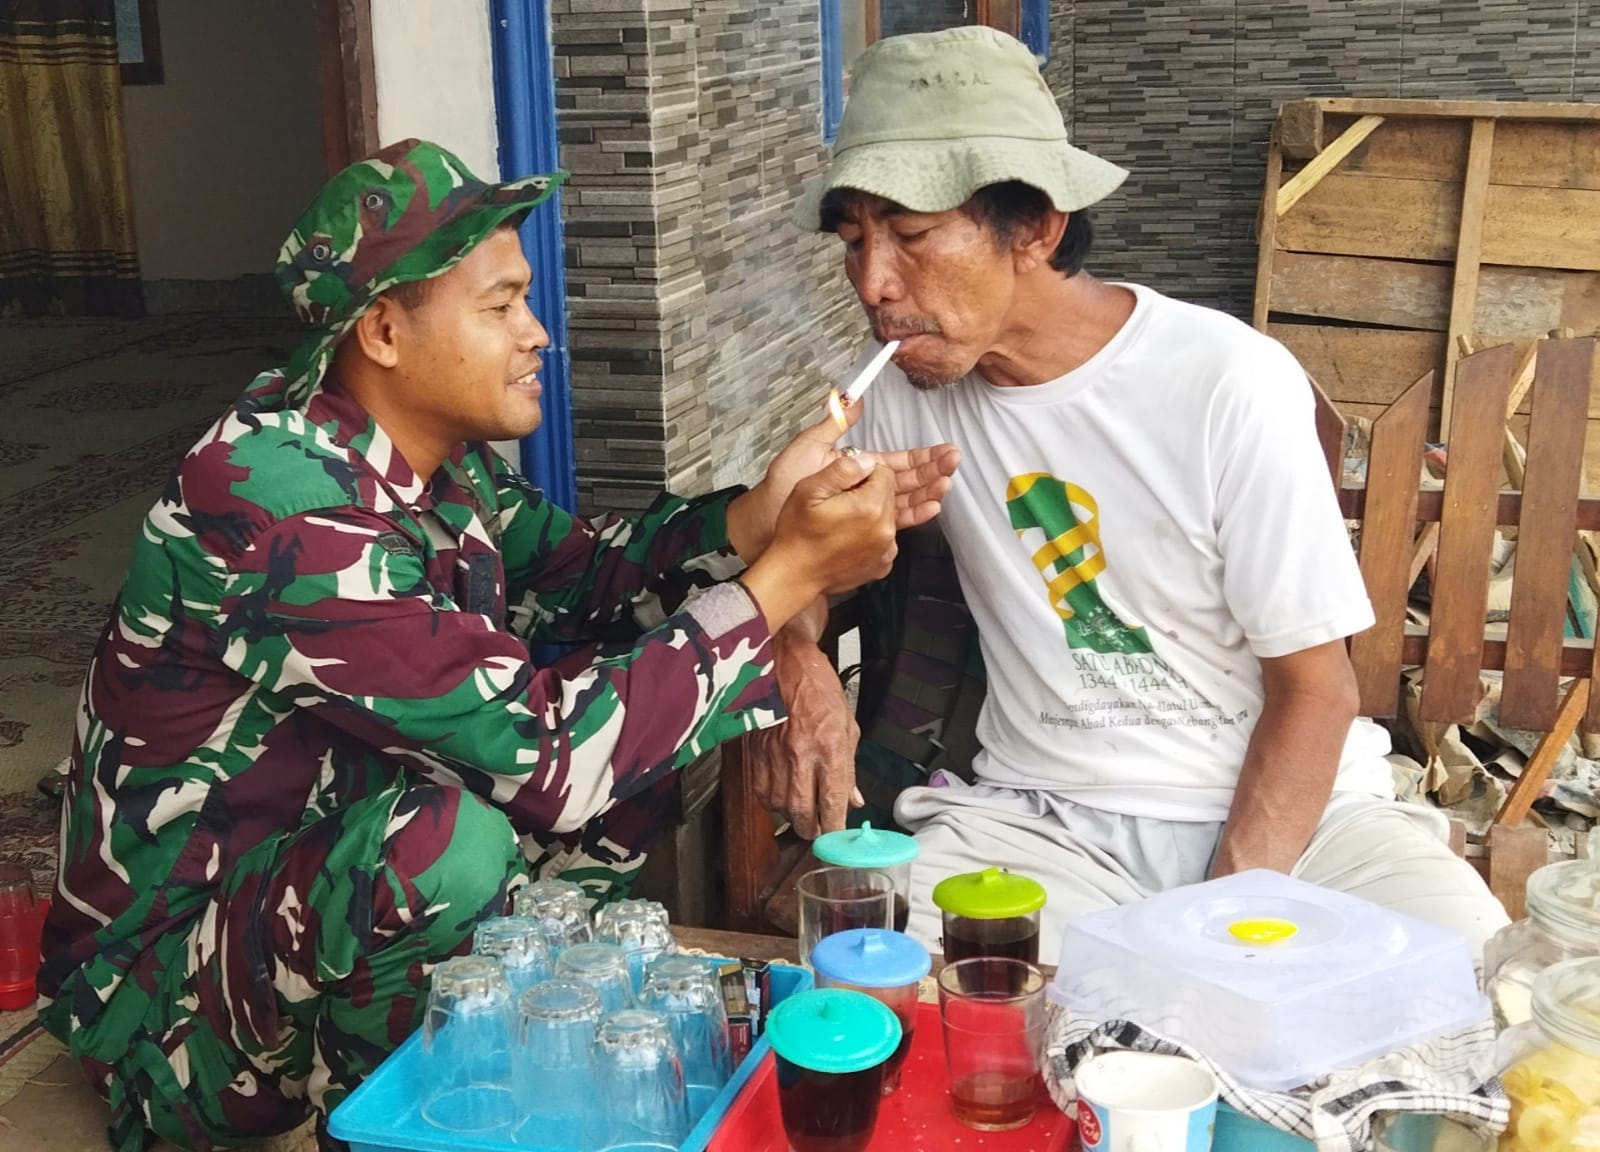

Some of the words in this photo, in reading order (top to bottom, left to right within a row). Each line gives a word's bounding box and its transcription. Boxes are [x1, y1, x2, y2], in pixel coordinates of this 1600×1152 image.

[1080, 672, 1118, 689] 1344
[1129, 675, 1171, 693] 1444
[1066, 697, 1138, 715] ndigdayakan
[1080, 715, 1106, 730] Abad
[1108, 714, 1142, 728] Kedua
